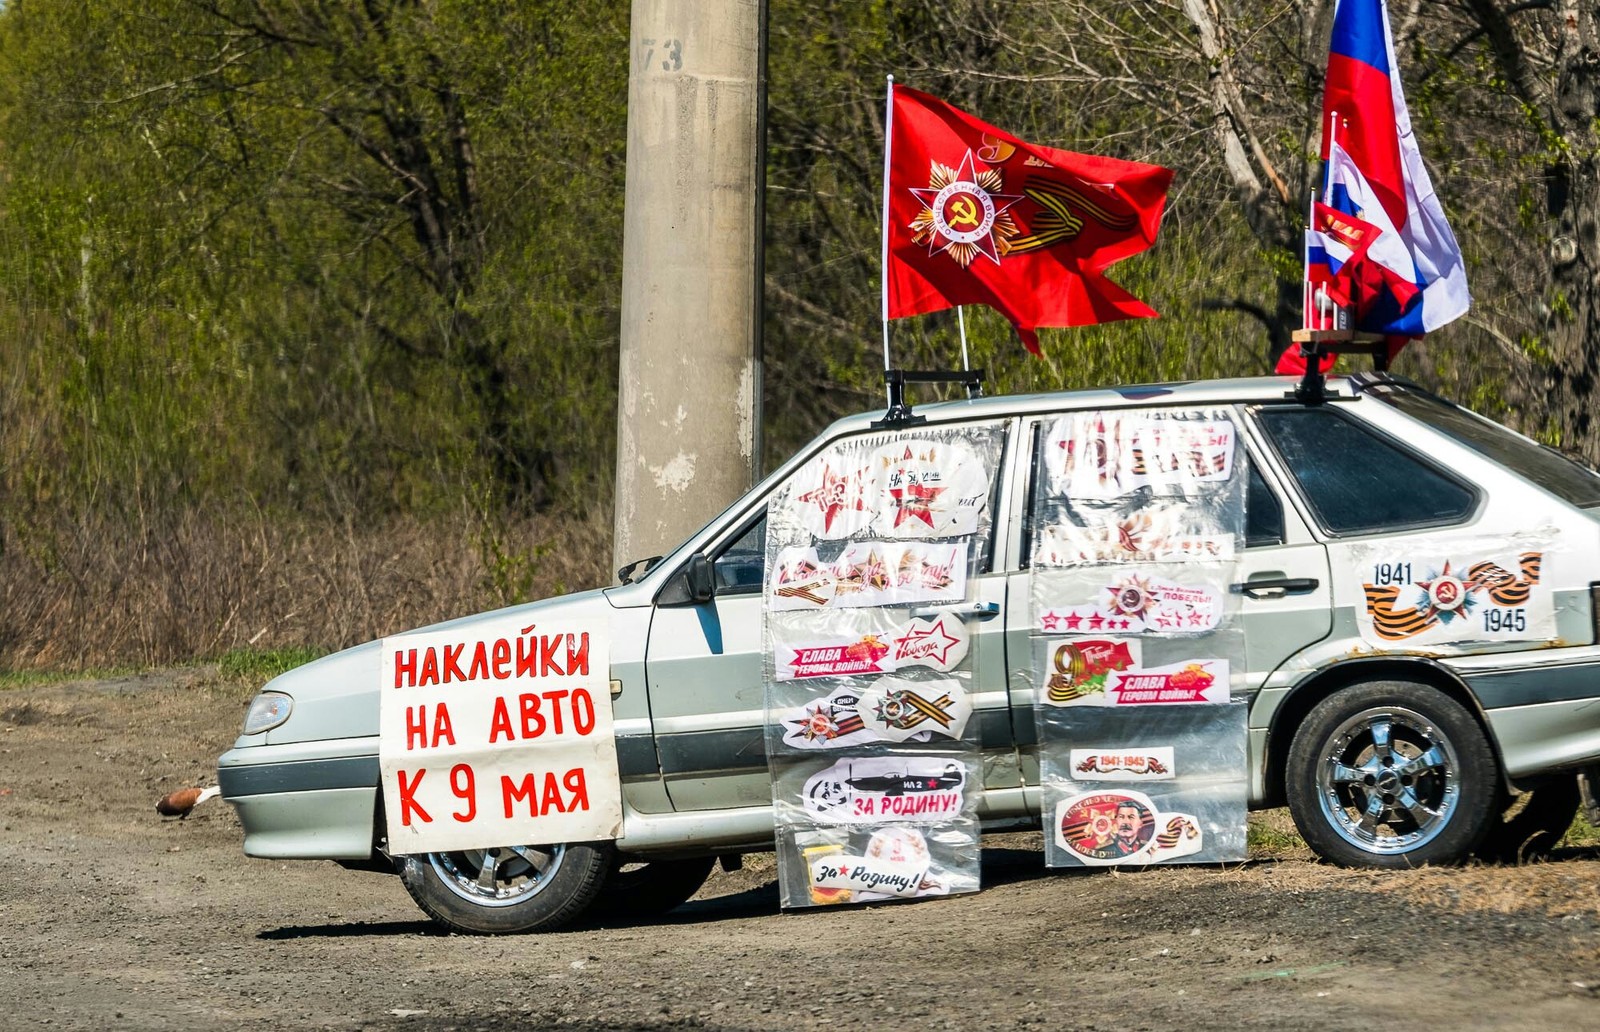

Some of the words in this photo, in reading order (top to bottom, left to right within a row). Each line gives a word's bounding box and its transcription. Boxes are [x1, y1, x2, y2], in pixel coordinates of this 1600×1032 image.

[641, 38, 683, 72] 73
[1373, 562, 1412, 586] 1941
[1483, 608, 1526, 632] 1945
[801, 648, 842, 664] СЛАВА
[1124, 676, 1167, 690] СЛАВА
[406, 702, 456, 751] НА
[489, 688, 596, 744] АВТО
[1100, 756, 1145, 766] 1941-1945
[397, 768, 434, 826] К
[449, 763, 477, 823] 9
[500, 767, 590, 819] МАЯ
[903, 781, 915, 789] ИЛ
[915, 781, 923, 789] 2
[854, 798, 874, 816] ЗА
[881, 794, 958, 816] РОДИНУ!
[816, 866, 837, 883] За
[850, 866, 919, 892] Родину!
